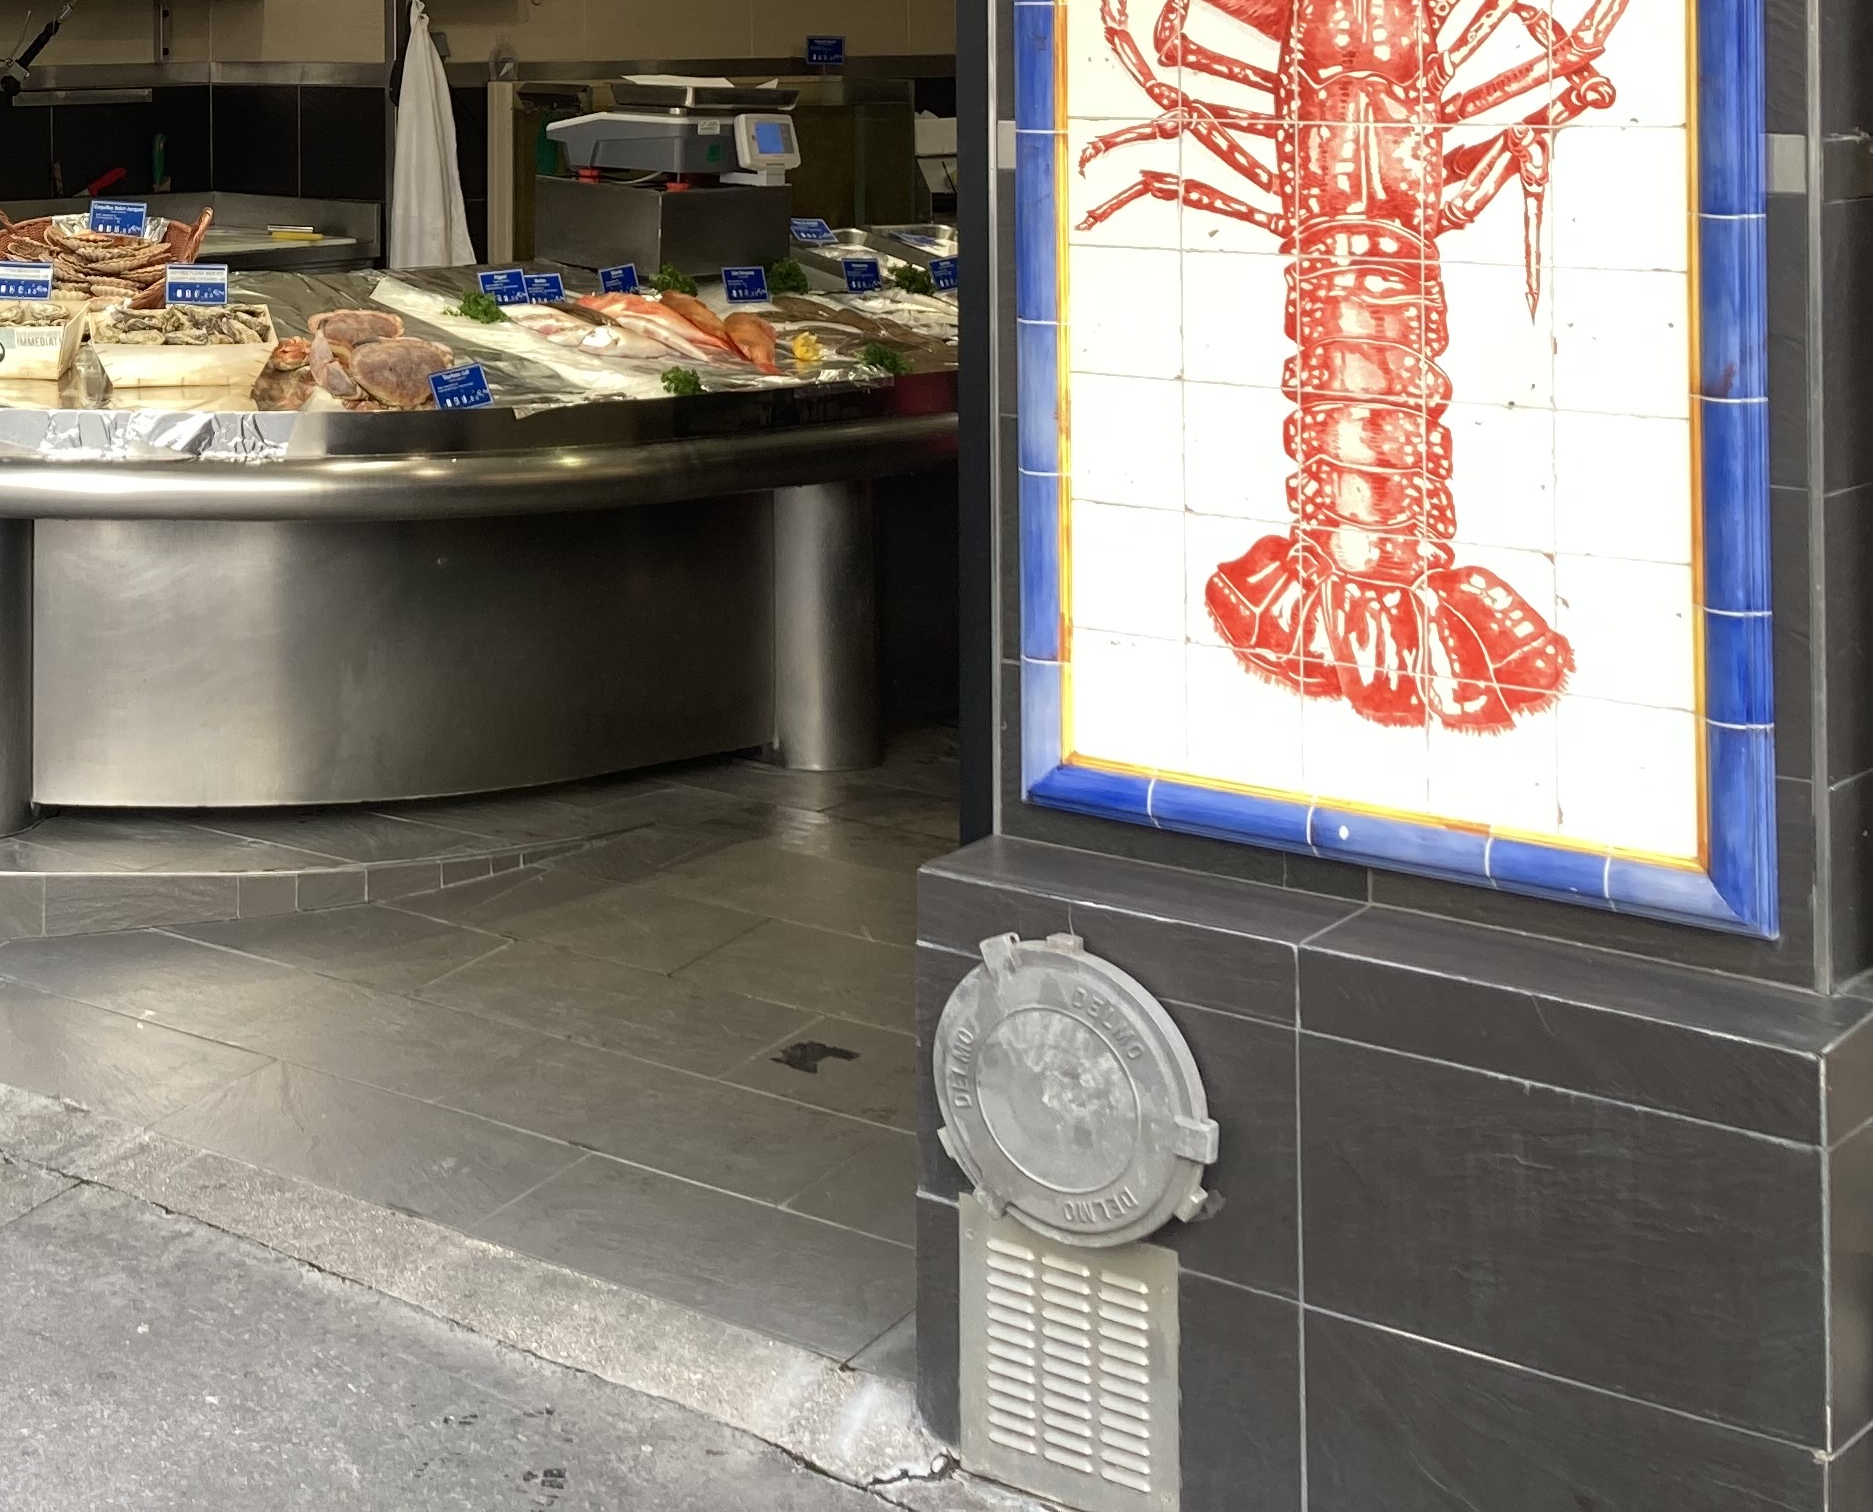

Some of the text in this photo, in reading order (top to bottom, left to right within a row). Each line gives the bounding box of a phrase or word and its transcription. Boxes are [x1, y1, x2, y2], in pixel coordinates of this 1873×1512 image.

[1070, 986, 1145, 1062] DELMO
[954, 1025, 974, 1109] DELMO
[1063, 1185, 1140, 1225] DELMO
